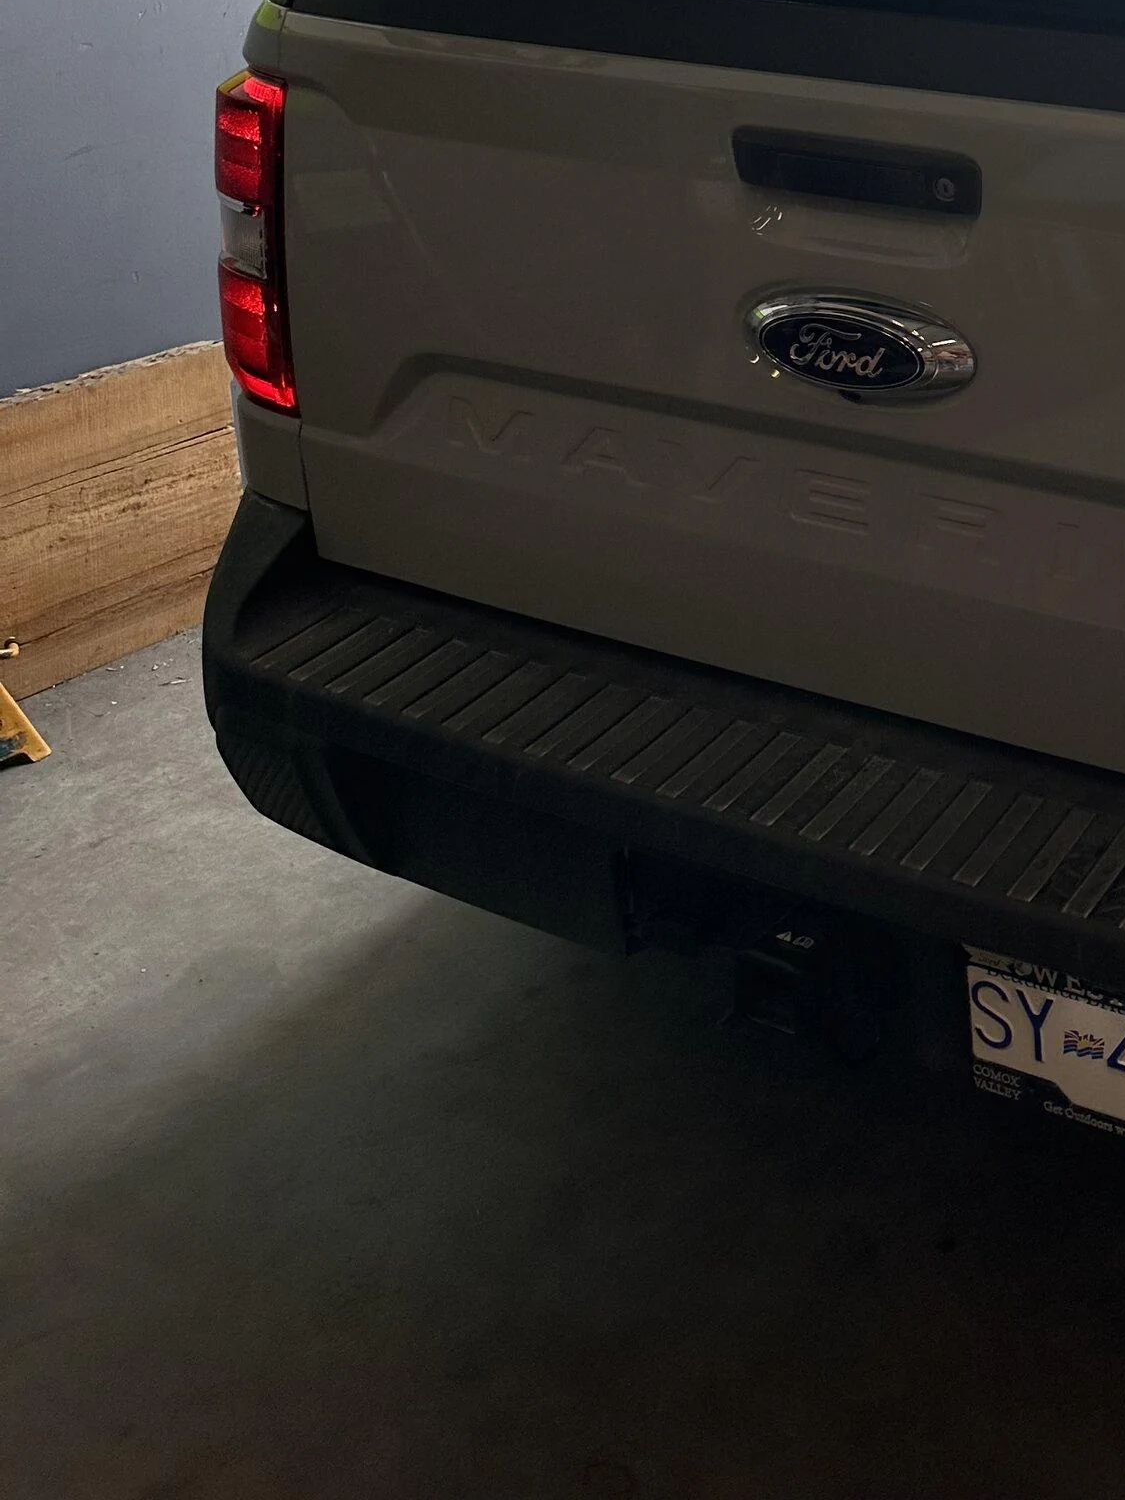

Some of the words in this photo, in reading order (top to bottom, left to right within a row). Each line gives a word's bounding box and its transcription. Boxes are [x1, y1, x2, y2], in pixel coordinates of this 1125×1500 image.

[789, 322, 885, 378] Ford
[970, 980, 1055, 1064] SY
[973, 1062, 1022, 1088] COMOX
[973, 1075, 1022, 1101] VALLEY
[1043, 1100, 1064, 1117] Get
[1065, 1107, 1114, 1133] Outdoors
